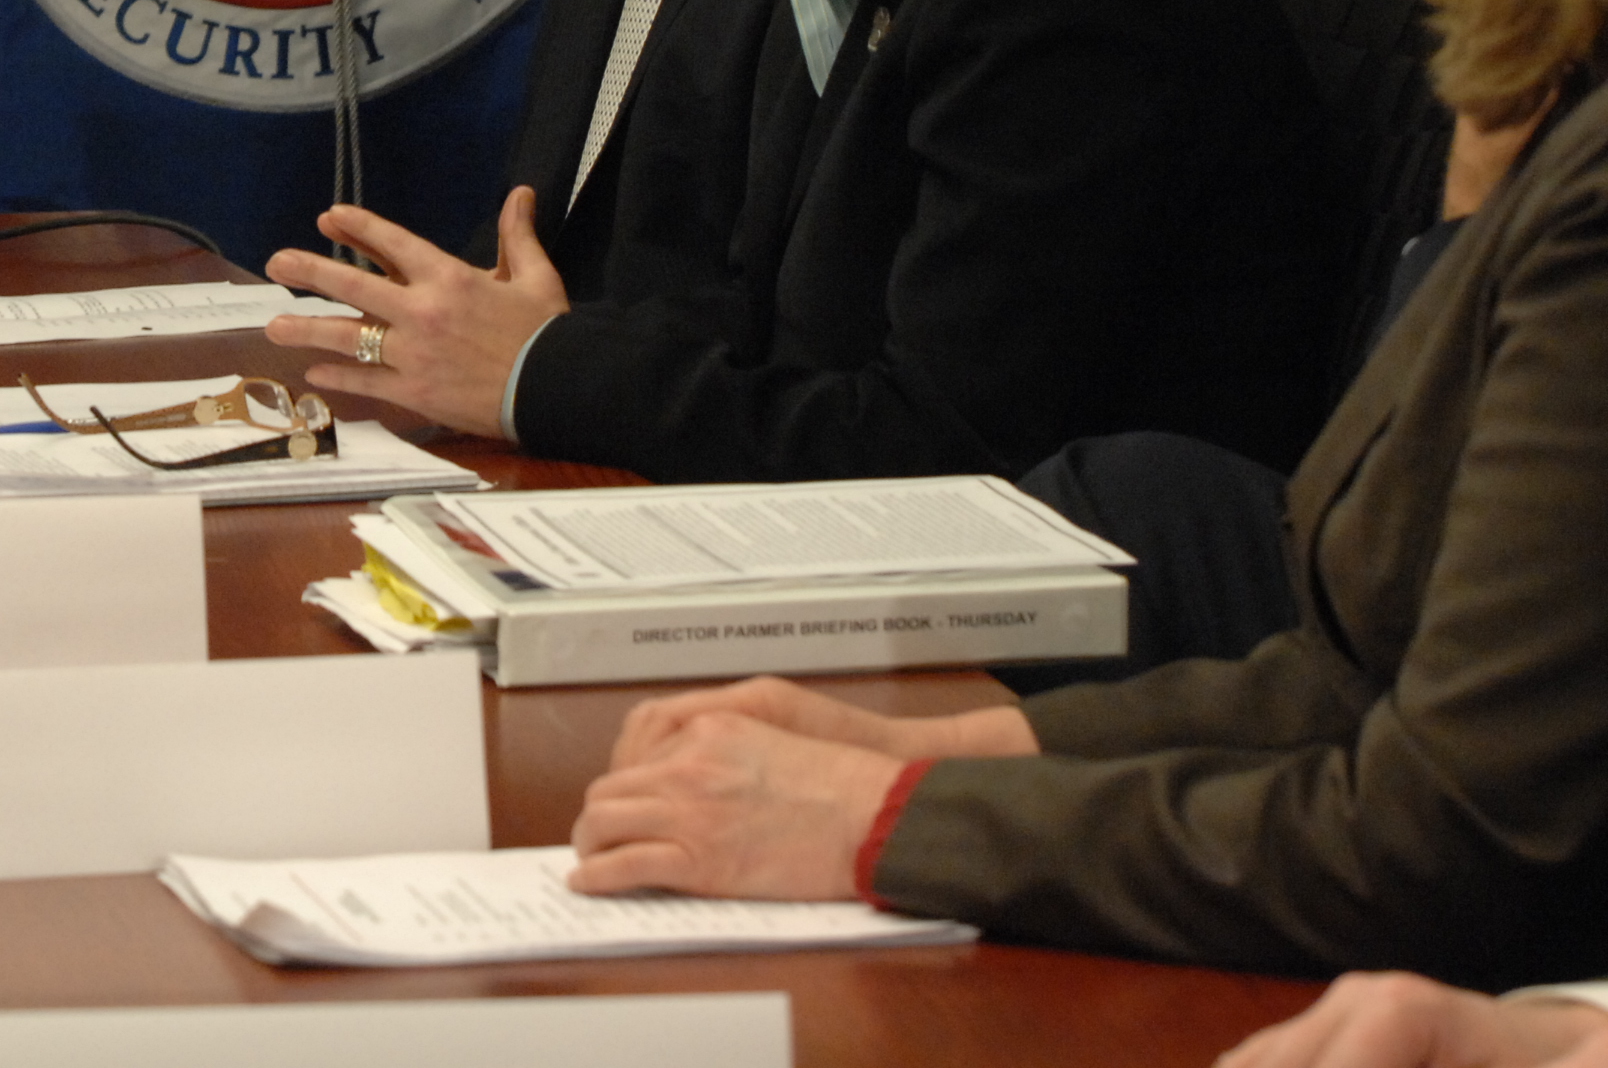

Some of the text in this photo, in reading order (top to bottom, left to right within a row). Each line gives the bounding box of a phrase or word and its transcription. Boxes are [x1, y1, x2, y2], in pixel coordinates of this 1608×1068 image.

[632, 626, 719, 644] DIRECTOR
[724, 622, 794, 639] PARMER
[800, 618, 877, 636] BRIEFING
[883, 615, 932, 631] BOOK
[947, 611, 1037, 628] THURSDAY
